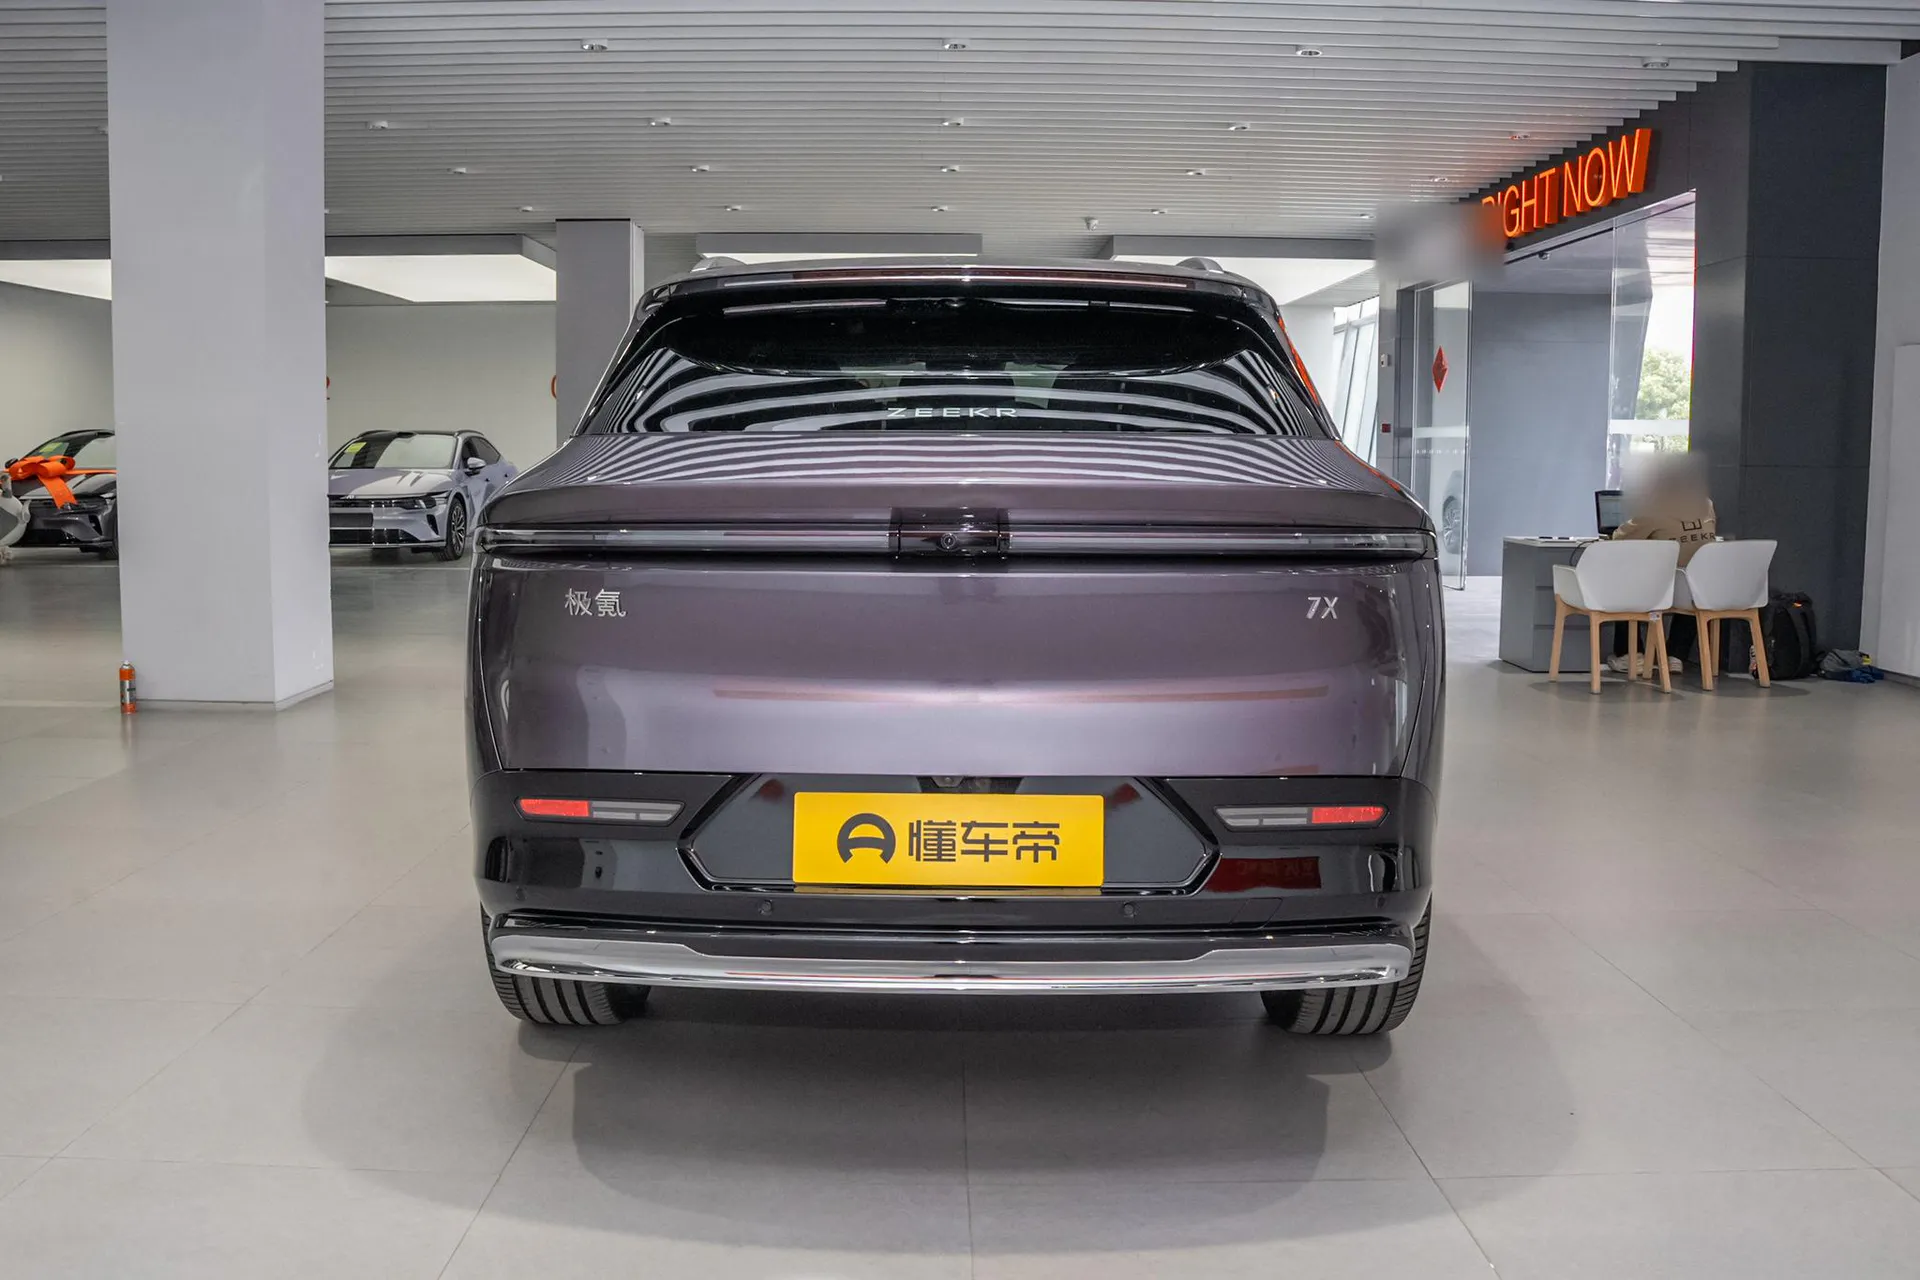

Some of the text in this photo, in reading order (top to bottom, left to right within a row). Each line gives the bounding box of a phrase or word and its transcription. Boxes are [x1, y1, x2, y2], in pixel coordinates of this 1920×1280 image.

[1481, 128, 1651, 238] GHT NOW
[887, 407, 1017, 418] ZEEKR
[564, 587, 627, 617] 极氪
[1306, 596, 1338, 619] 7X
[908, 820, 1060, 863] 懂车帝
